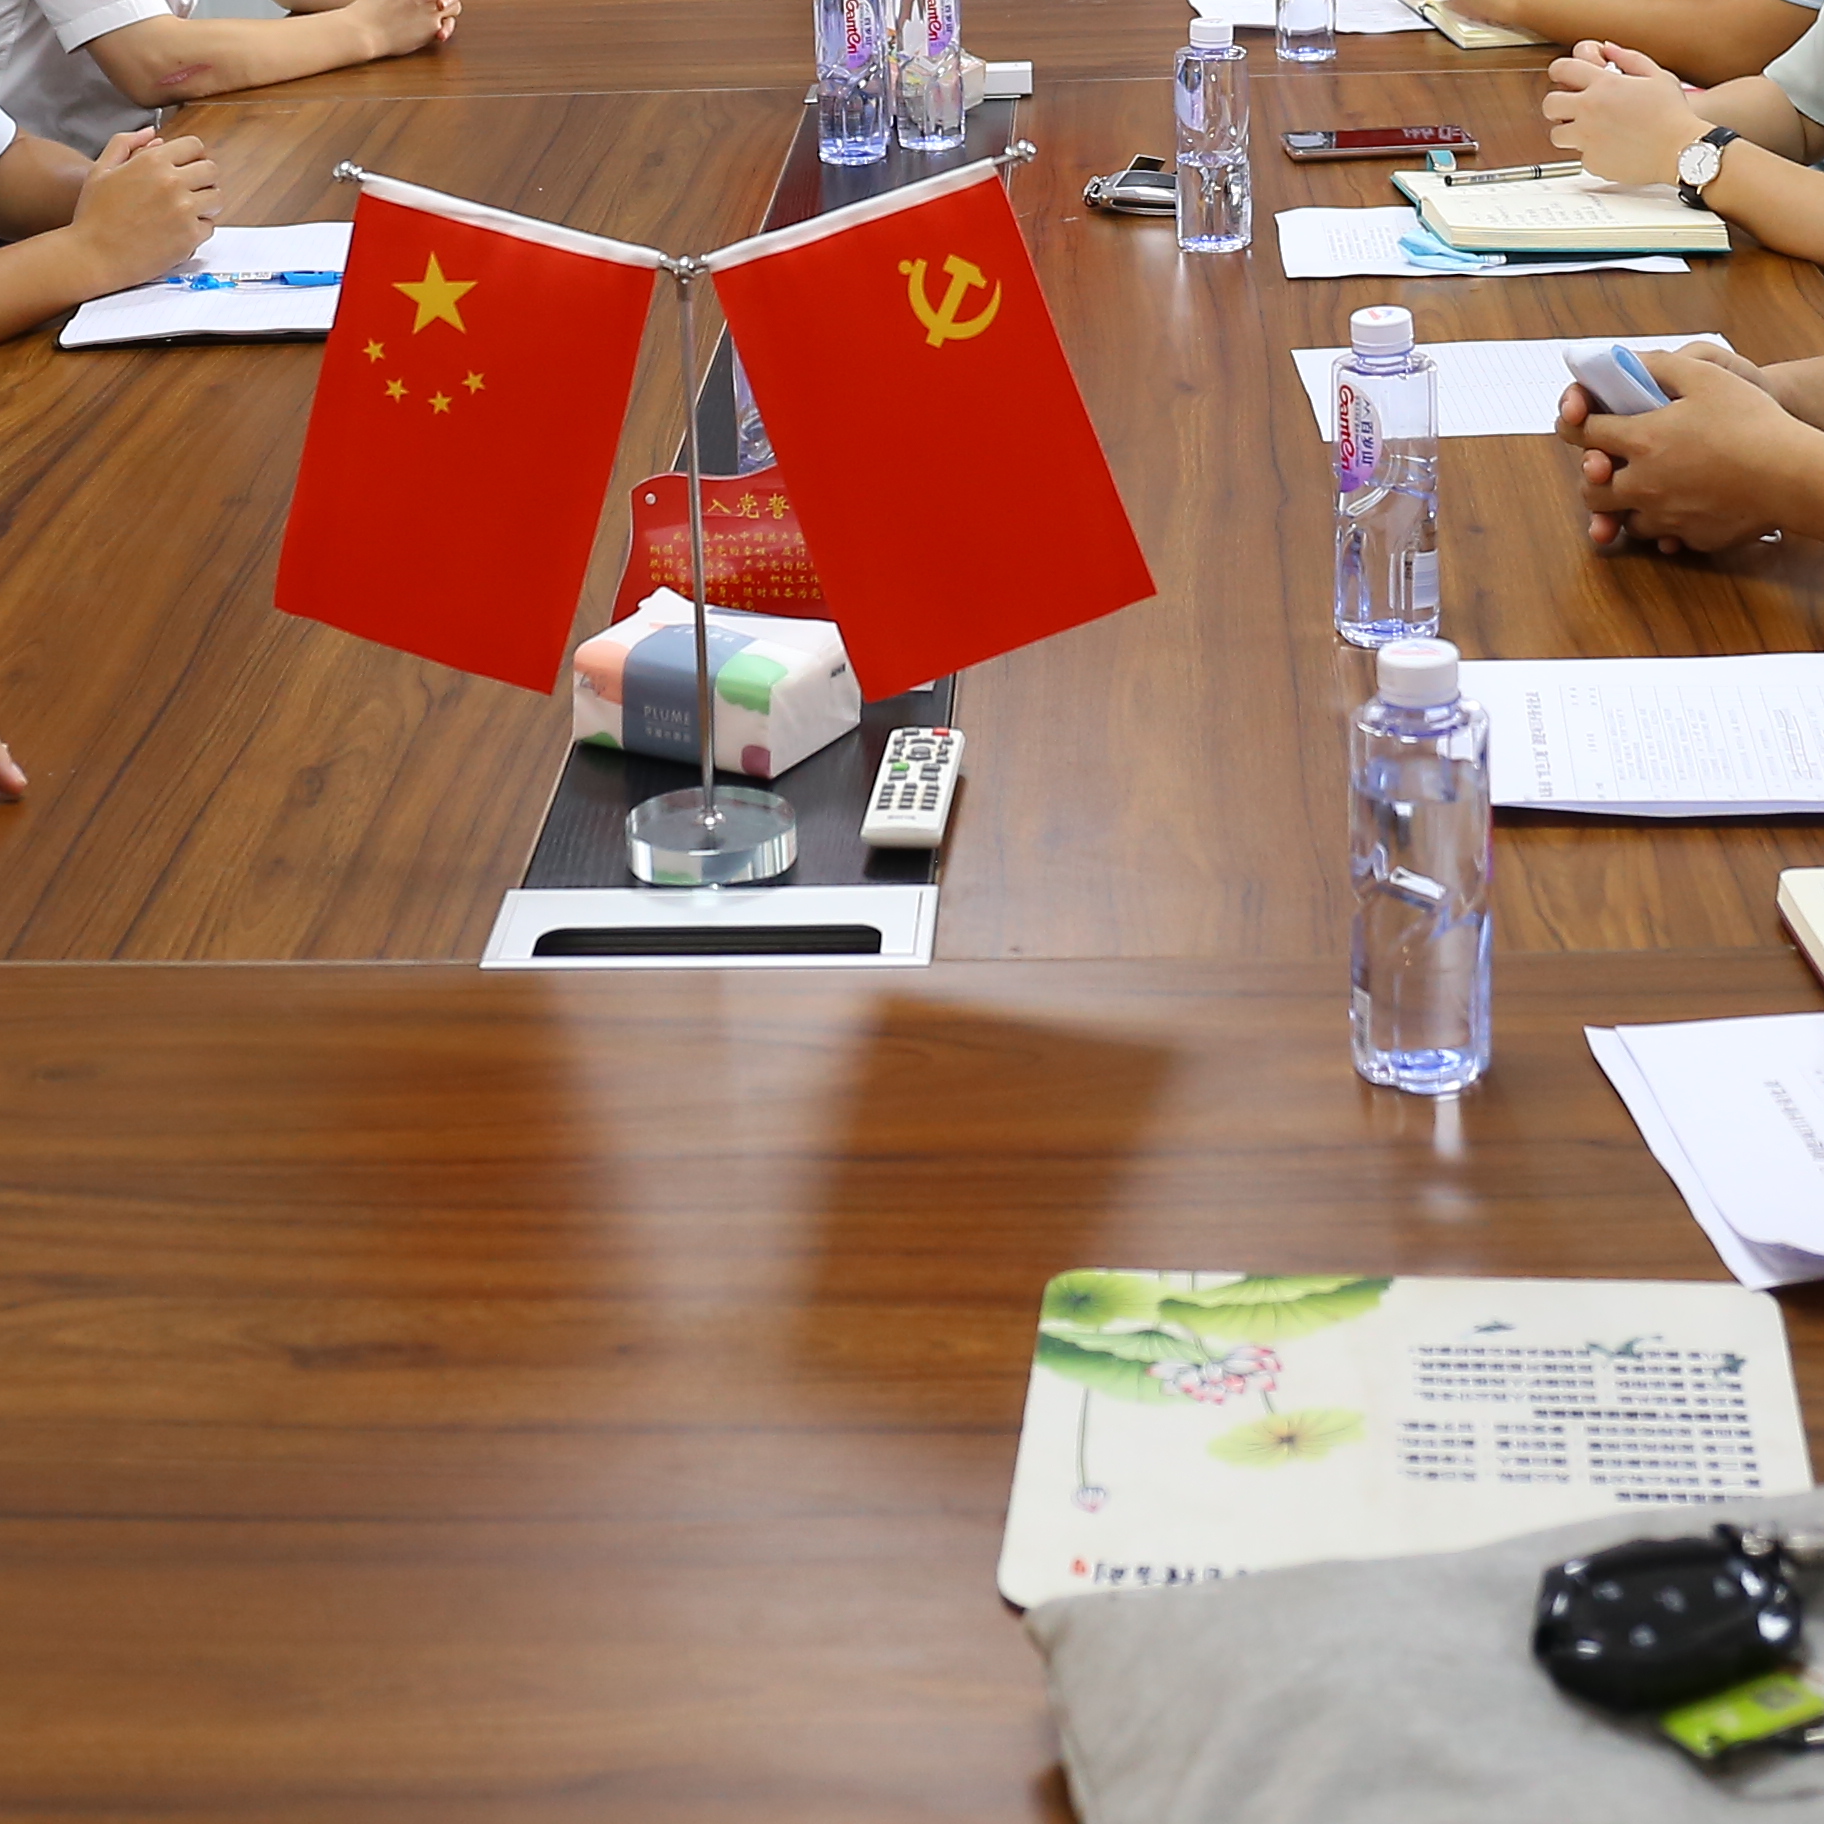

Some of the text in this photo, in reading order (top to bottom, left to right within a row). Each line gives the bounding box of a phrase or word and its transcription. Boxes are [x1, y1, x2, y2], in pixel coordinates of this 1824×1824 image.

[1360, 419, 1375, 468] 百岁山
[707, 492, 791, 520] 入党誓
